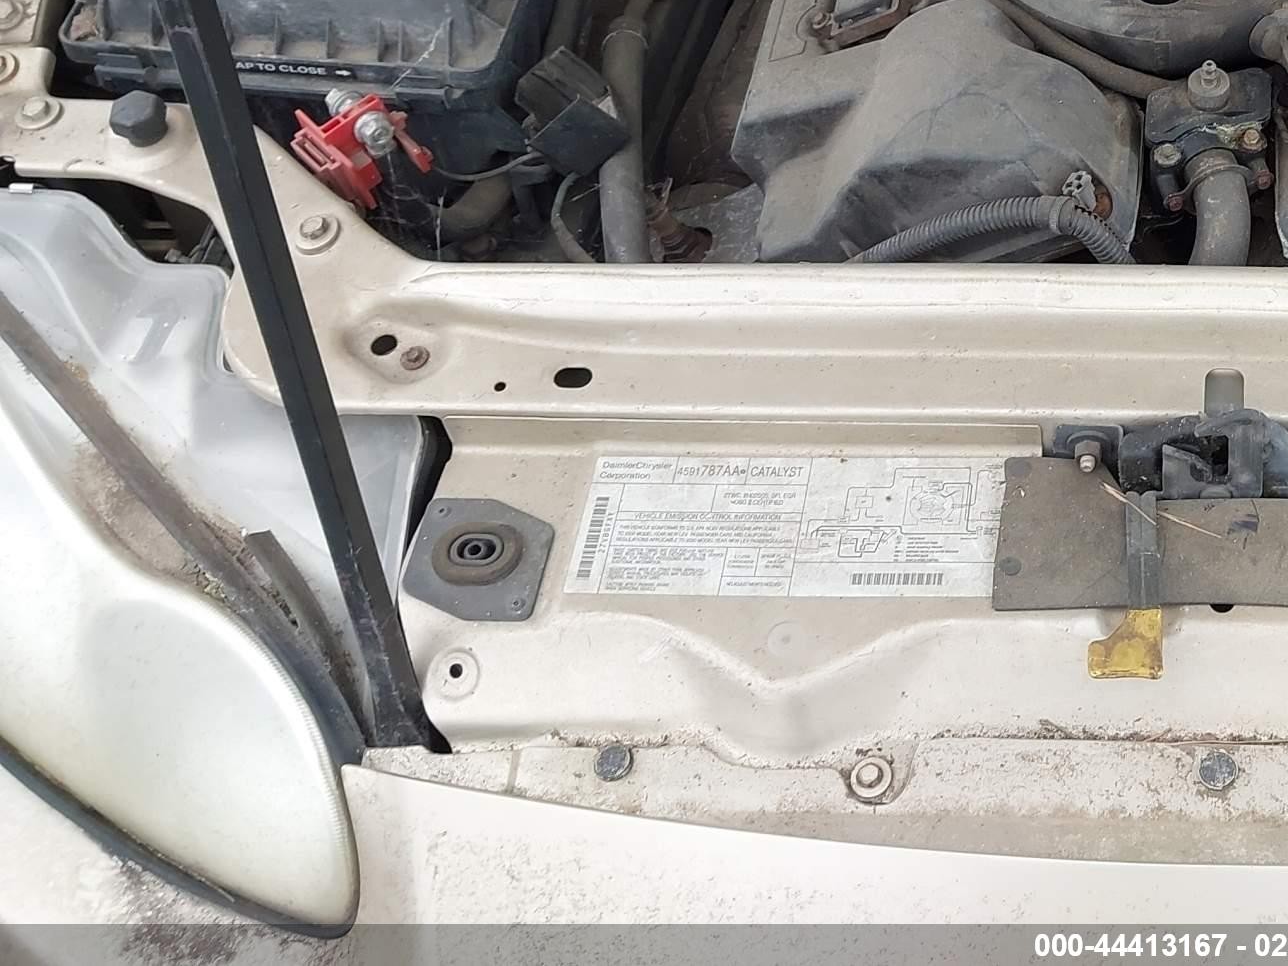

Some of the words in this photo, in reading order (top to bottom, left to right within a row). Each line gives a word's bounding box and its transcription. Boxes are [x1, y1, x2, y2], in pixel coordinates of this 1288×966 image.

[255, 63, 276, 71] TO
[279, 64, 327, 75] CLOSE
[602, 461, 672, 471] DaimlerChrysler
[600, 471, 651, 479] Corporation
[751, 466, 803, 477] CATALYST
